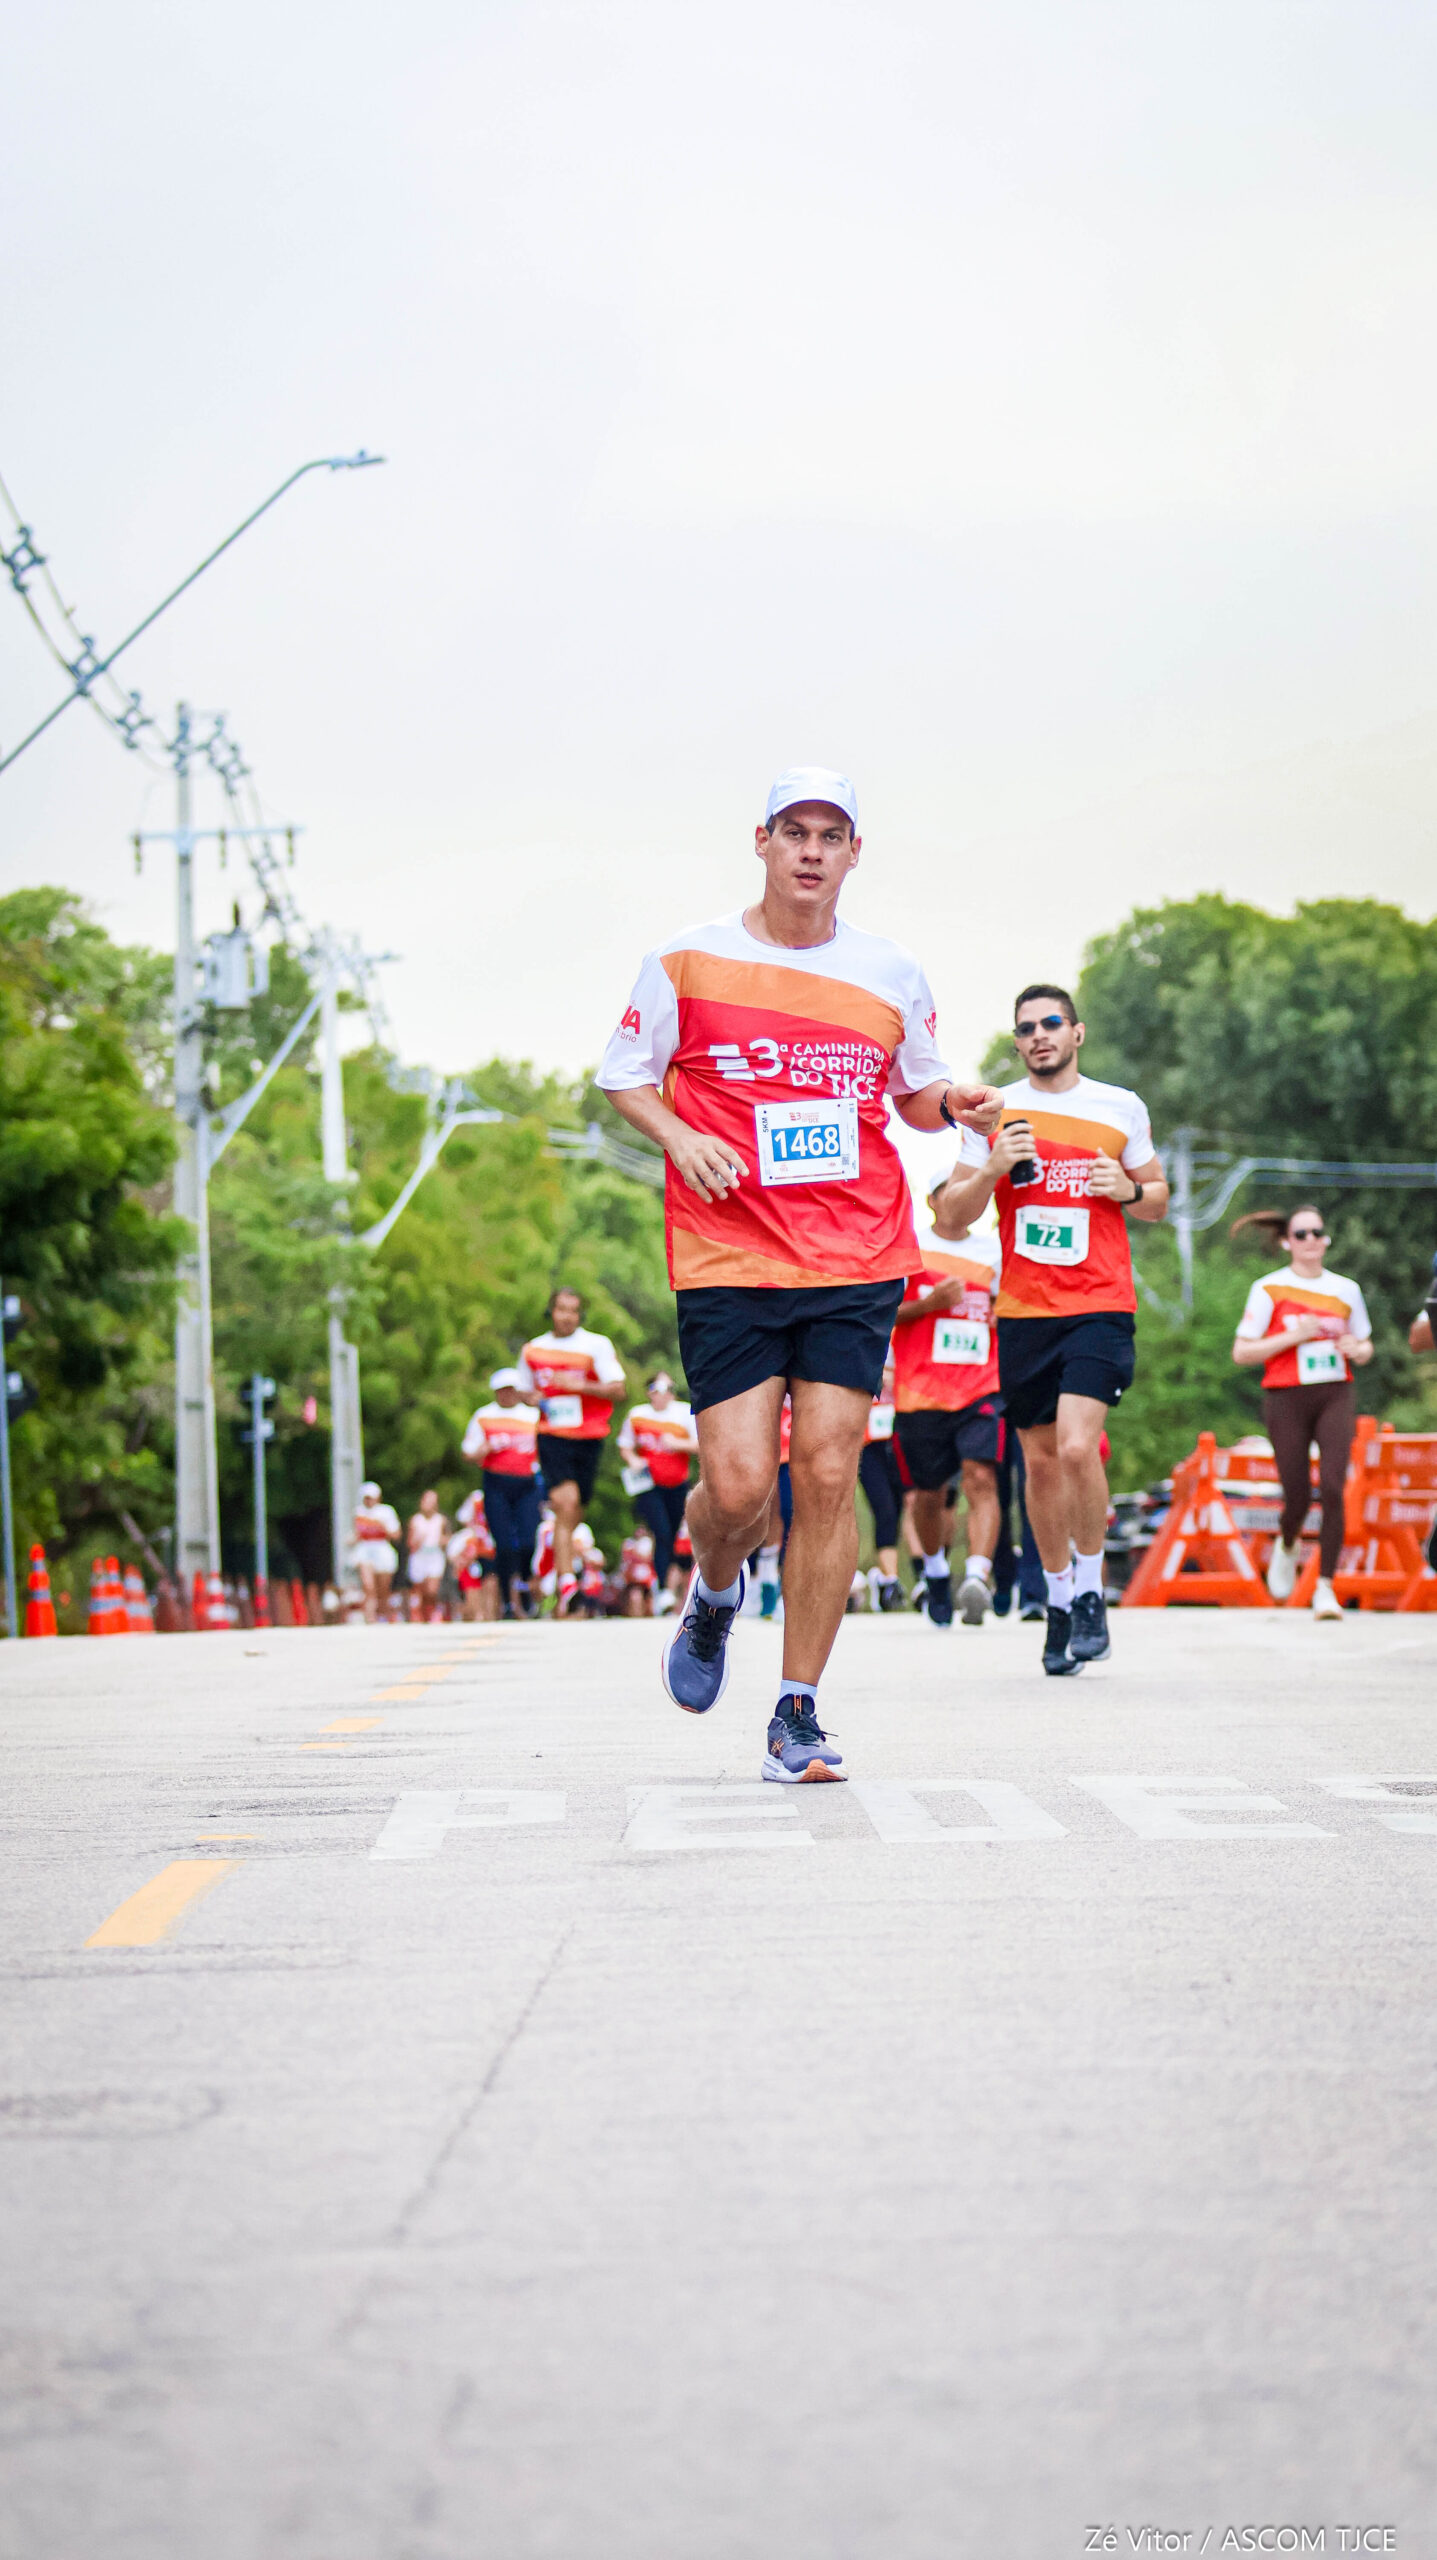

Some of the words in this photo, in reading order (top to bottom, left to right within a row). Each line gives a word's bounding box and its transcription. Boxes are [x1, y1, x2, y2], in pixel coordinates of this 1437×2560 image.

[793, 1042, 885, 1063] CAMINHADA
[790, 1070, 823, 1087] DO
[826, 1074, 877, 1101] TJCE
[774, 1126, 840, 1159] 1468
[1046, 1178, 1067, 1193] DO
[1037, 1225, 1061, 1247] 72
